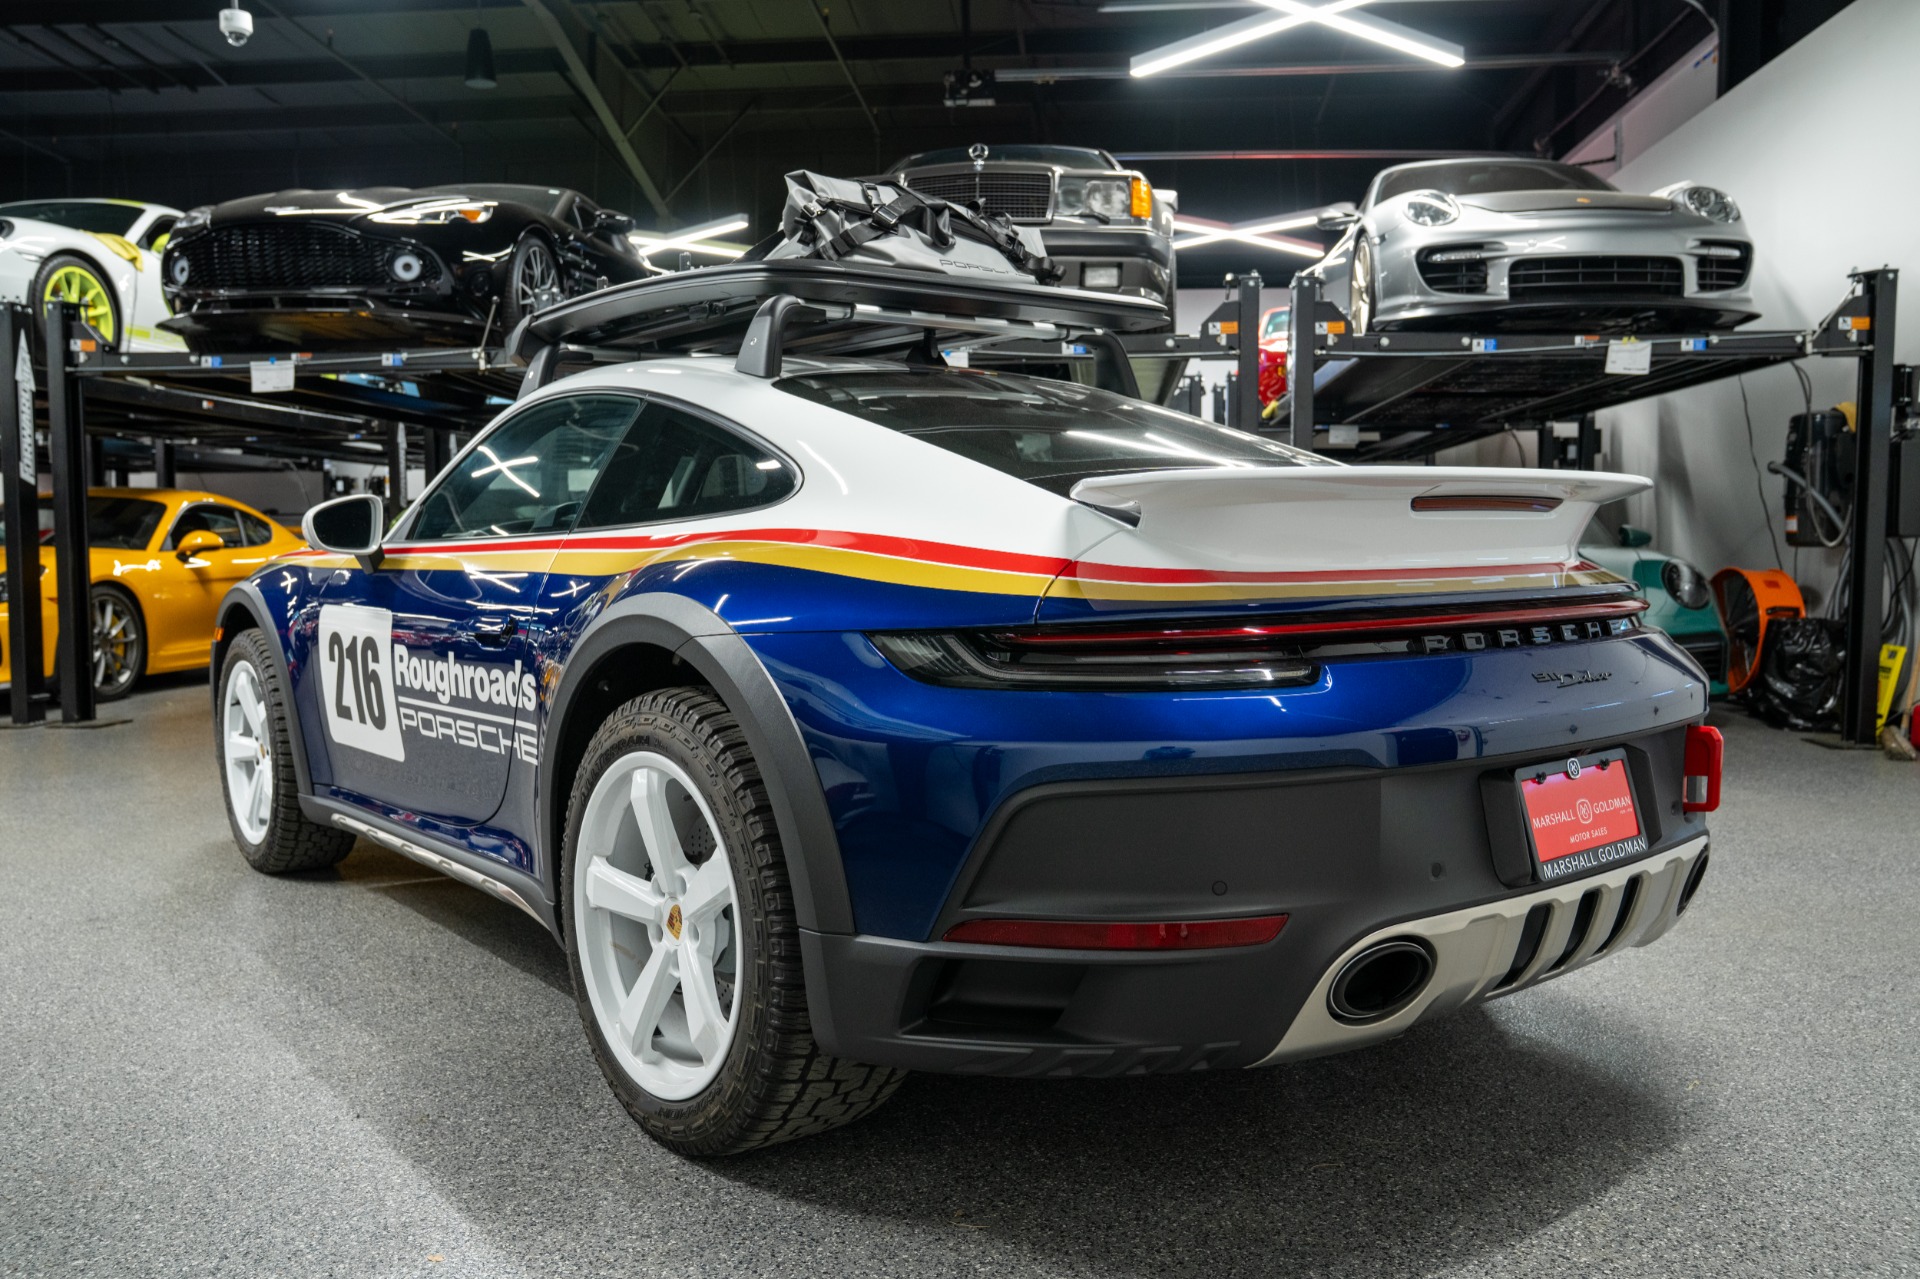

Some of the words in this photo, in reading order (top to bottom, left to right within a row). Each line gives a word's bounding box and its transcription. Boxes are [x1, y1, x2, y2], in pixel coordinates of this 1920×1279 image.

[939, 259, 1030, 278] PORSC
[1421, 617, 1632, 655] PORSCHE
[328, 631, 387, 731] 216
[394, 643, 536, 712] Roughroads
[400, 707, 538, 766] PORSCHE
[1532, 809, 1577, 829] MARSHALL
[1593, 795, 1633, 815] GOLDMAN
[1570, 830, 1591, 844] MOTOR
[1592, 826, 1608, 838] SALES
[1543, 851, 1598, 879] MARSHALL
[1598, 836, 1648, 863] GOLDMAN
